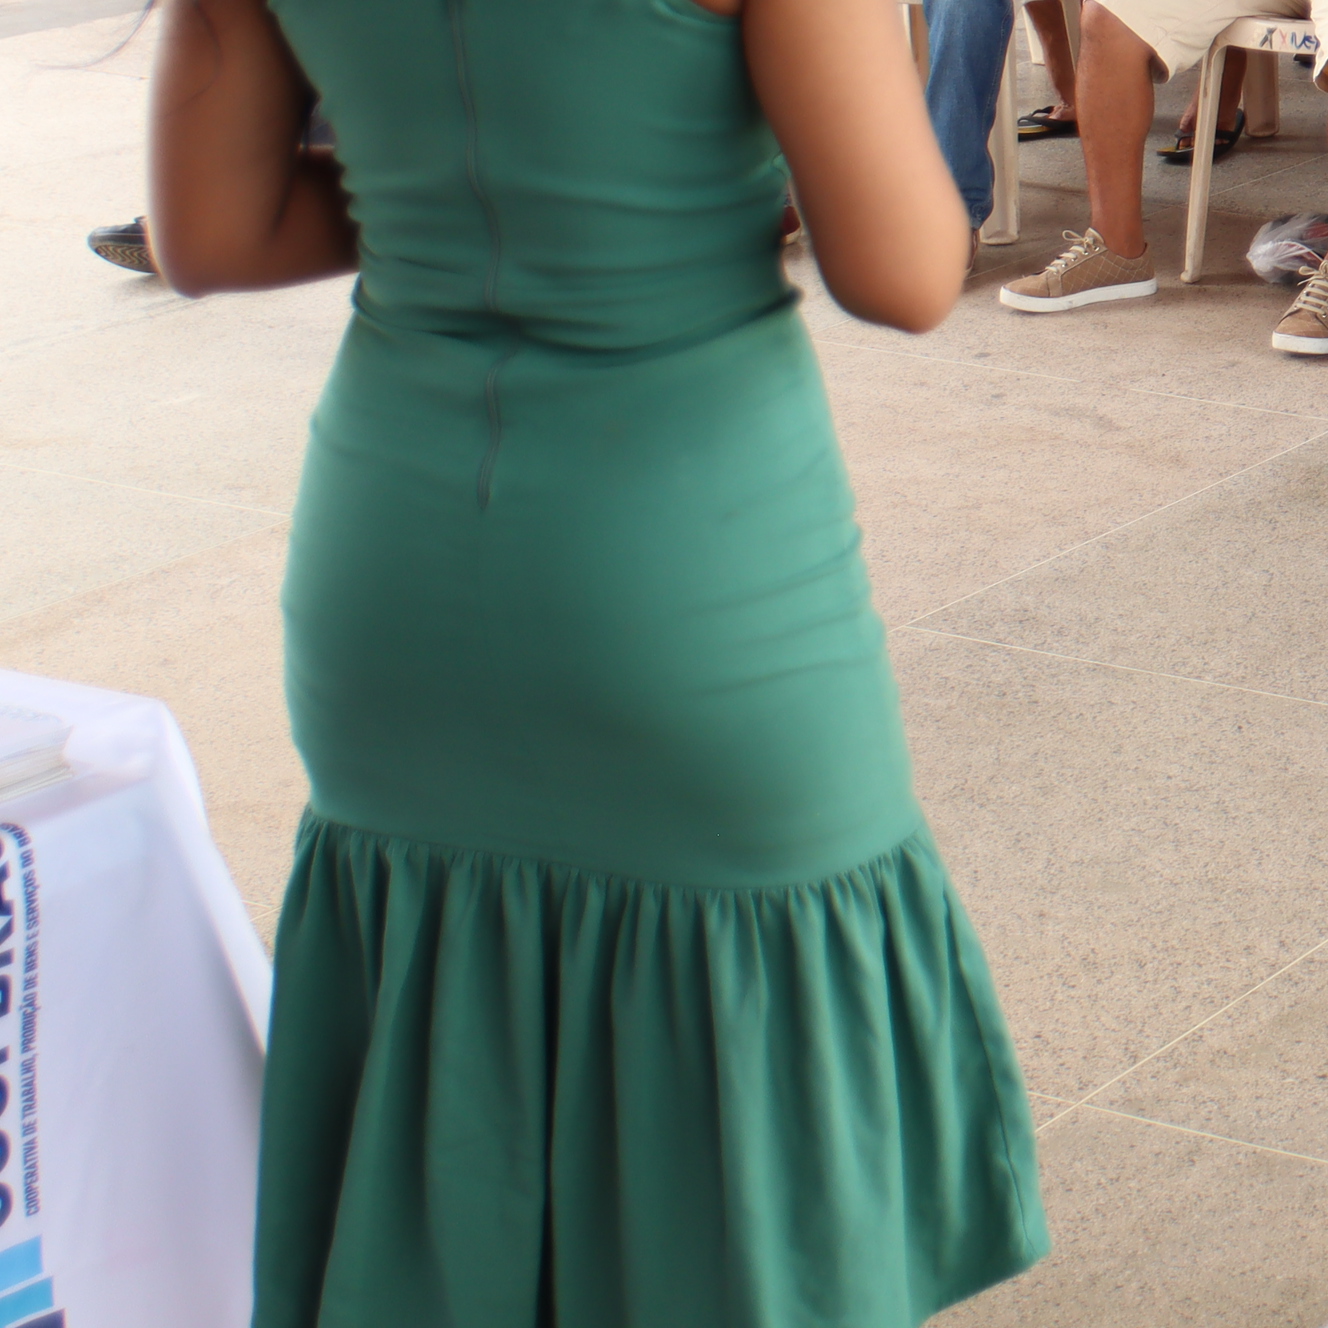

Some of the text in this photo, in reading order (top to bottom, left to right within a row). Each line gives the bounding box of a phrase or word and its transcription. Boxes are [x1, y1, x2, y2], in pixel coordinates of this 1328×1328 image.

[20, 848, 35, 869] DO
[23, 869, 40, 931] SERVIÇOS
[26, 930, 39, 941] E
[24, 940, 39, 974] BENS
[23, 973, 38, 991] DE
[20, 991, 41, 1055] PRODUÇÃO
[21, 1052, 39, 1119] TRABALHO,
[21, 1118, 38, 1137] DE
[22, 1135, 40, 1218] COOPERATIVA
